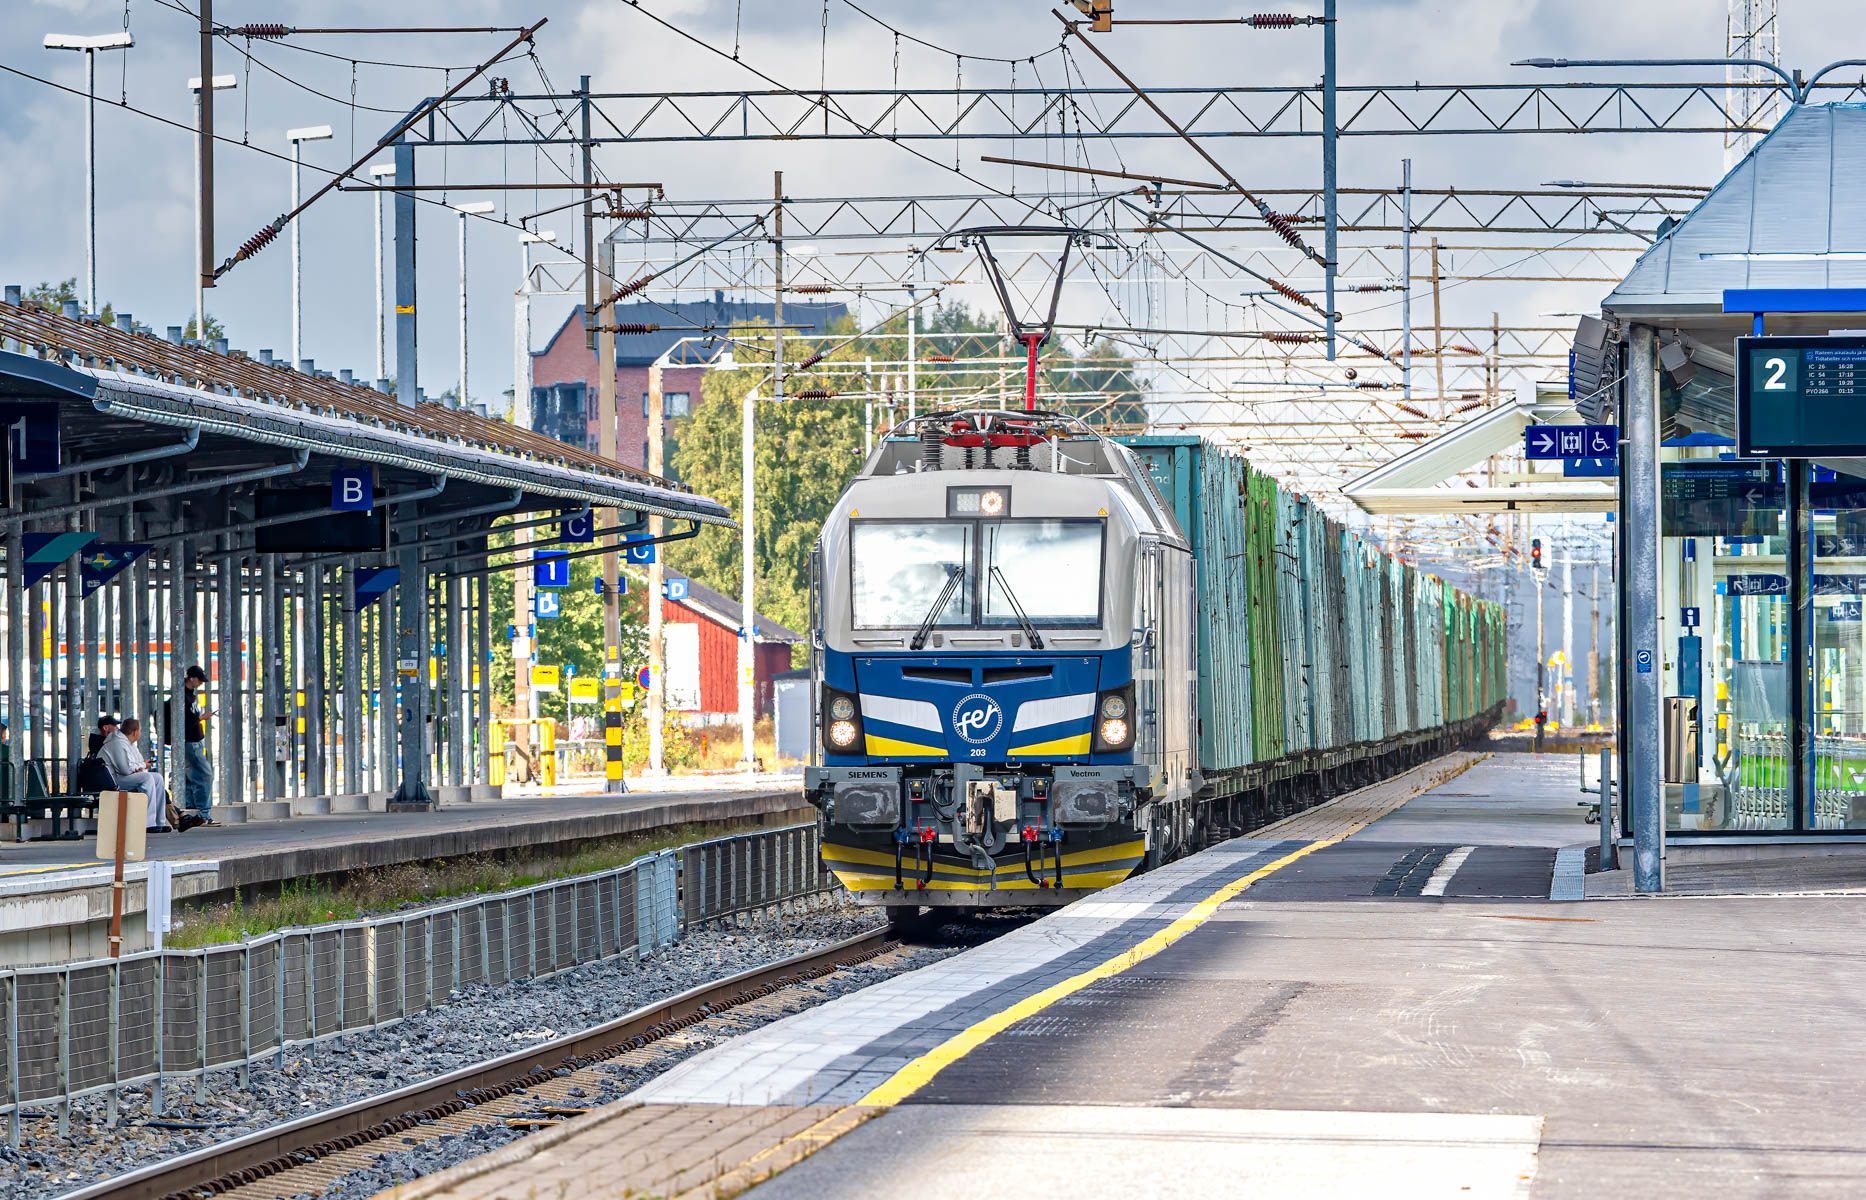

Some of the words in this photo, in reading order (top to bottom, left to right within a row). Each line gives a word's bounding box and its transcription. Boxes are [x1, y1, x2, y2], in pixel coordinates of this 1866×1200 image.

[1764, 357, 1786, 390] 2
[11, 415, 27, 460] 1
[343, 477, 363, 503] B
[568, 517, 587, 537] C
[547, 560, 556, 580] 1
[671, 583, 684, 597] D
[957, 704, 999, 738] fer
[970, 748, 987, 757] 203
[848, 771, 888, 779] SIEMENS
[1070, 770, 1101, 778] Vectron
